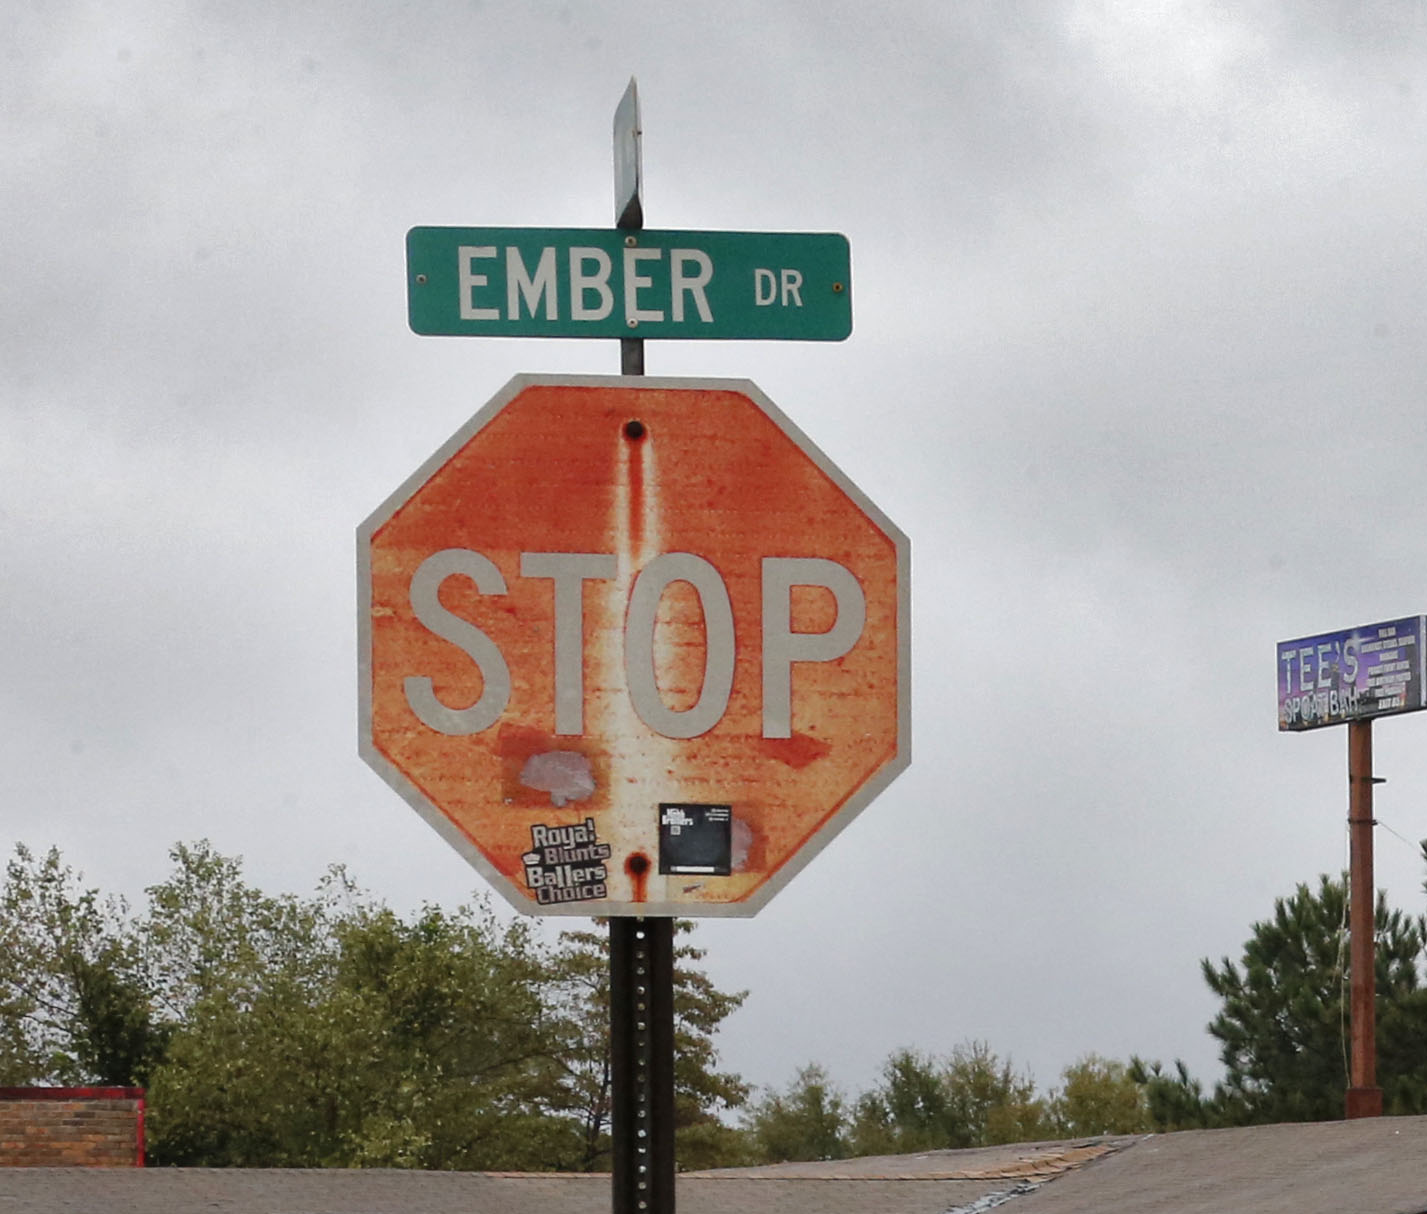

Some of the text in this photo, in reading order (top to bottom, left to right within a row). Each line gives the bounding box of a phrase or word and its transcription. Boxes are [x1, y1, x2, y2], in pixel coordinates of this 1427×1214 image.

[457, 245, 803, 323] EMBER DR
[402, 547, 867, 740] STOP
[1281, 638, 1359, 694] TEE'S
[543, 844, 609, 865] Blunts
[526, 864, 606, 889] Ballers
[537, 884, 606, 903] Choice
